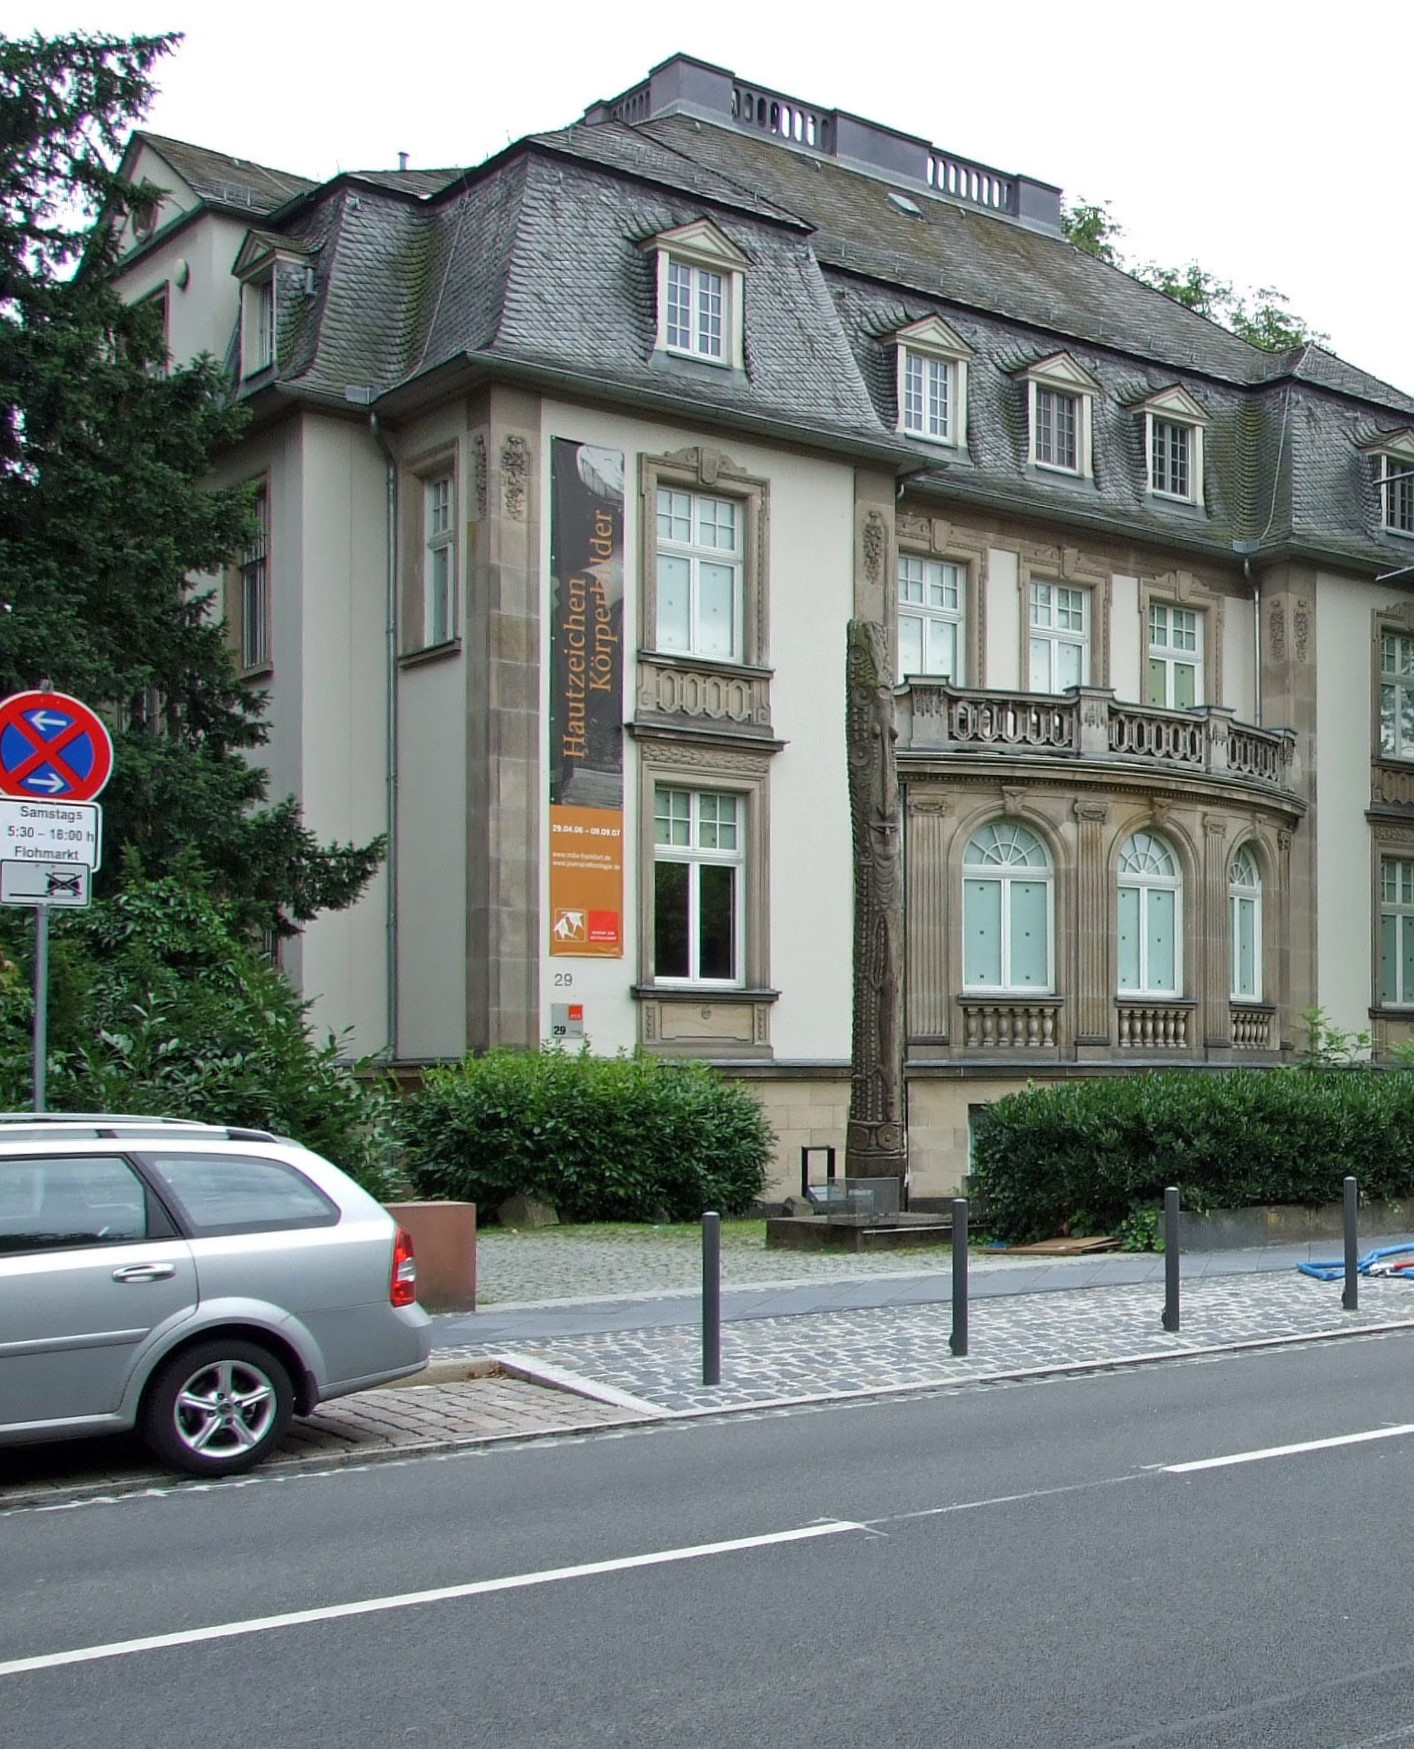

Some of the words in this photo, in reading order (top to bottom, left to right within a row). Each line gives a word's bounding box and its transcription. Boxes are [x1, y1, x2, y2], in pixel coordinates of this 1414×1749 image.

[590, 510, 618, 692] Körperbilder
[563, 578, 586, 759] Hautzeichen
[20, 806, 83, 823] Samstags
[7, 825, 34, 838] 5:30
[50, 828, 83, 841] 18:00
[87, 831, 94, 842] h
[15, 845, 79, 860] Flohmarkt
[554, 973, 573, 987] 29
[553, 1025, 567, 1036] 29
